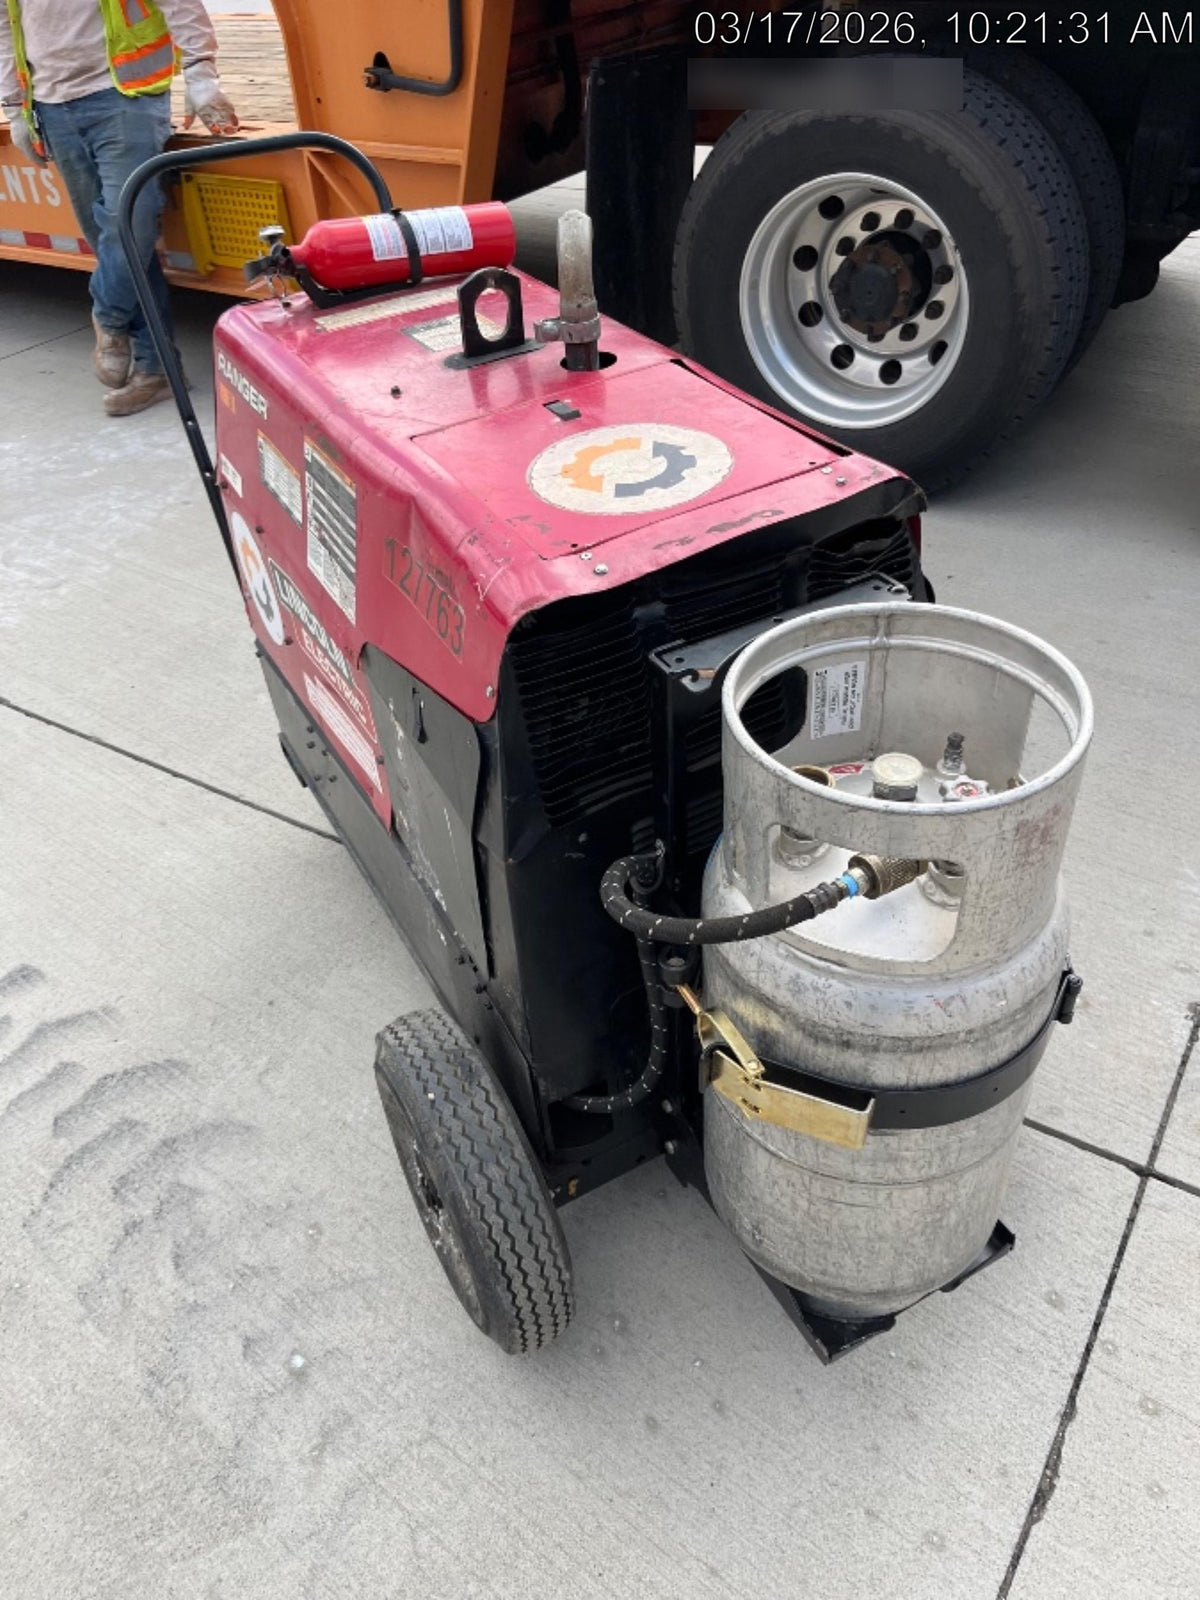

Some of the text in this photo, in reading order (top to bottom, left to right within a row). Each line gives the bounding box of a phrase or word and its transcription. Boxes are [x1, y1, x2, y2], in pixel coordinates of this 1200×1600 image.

[0, 164, 62, 207] NTS
[217, 355, 268, 420] RANGER
[384, 537, 464, 657] 127763
